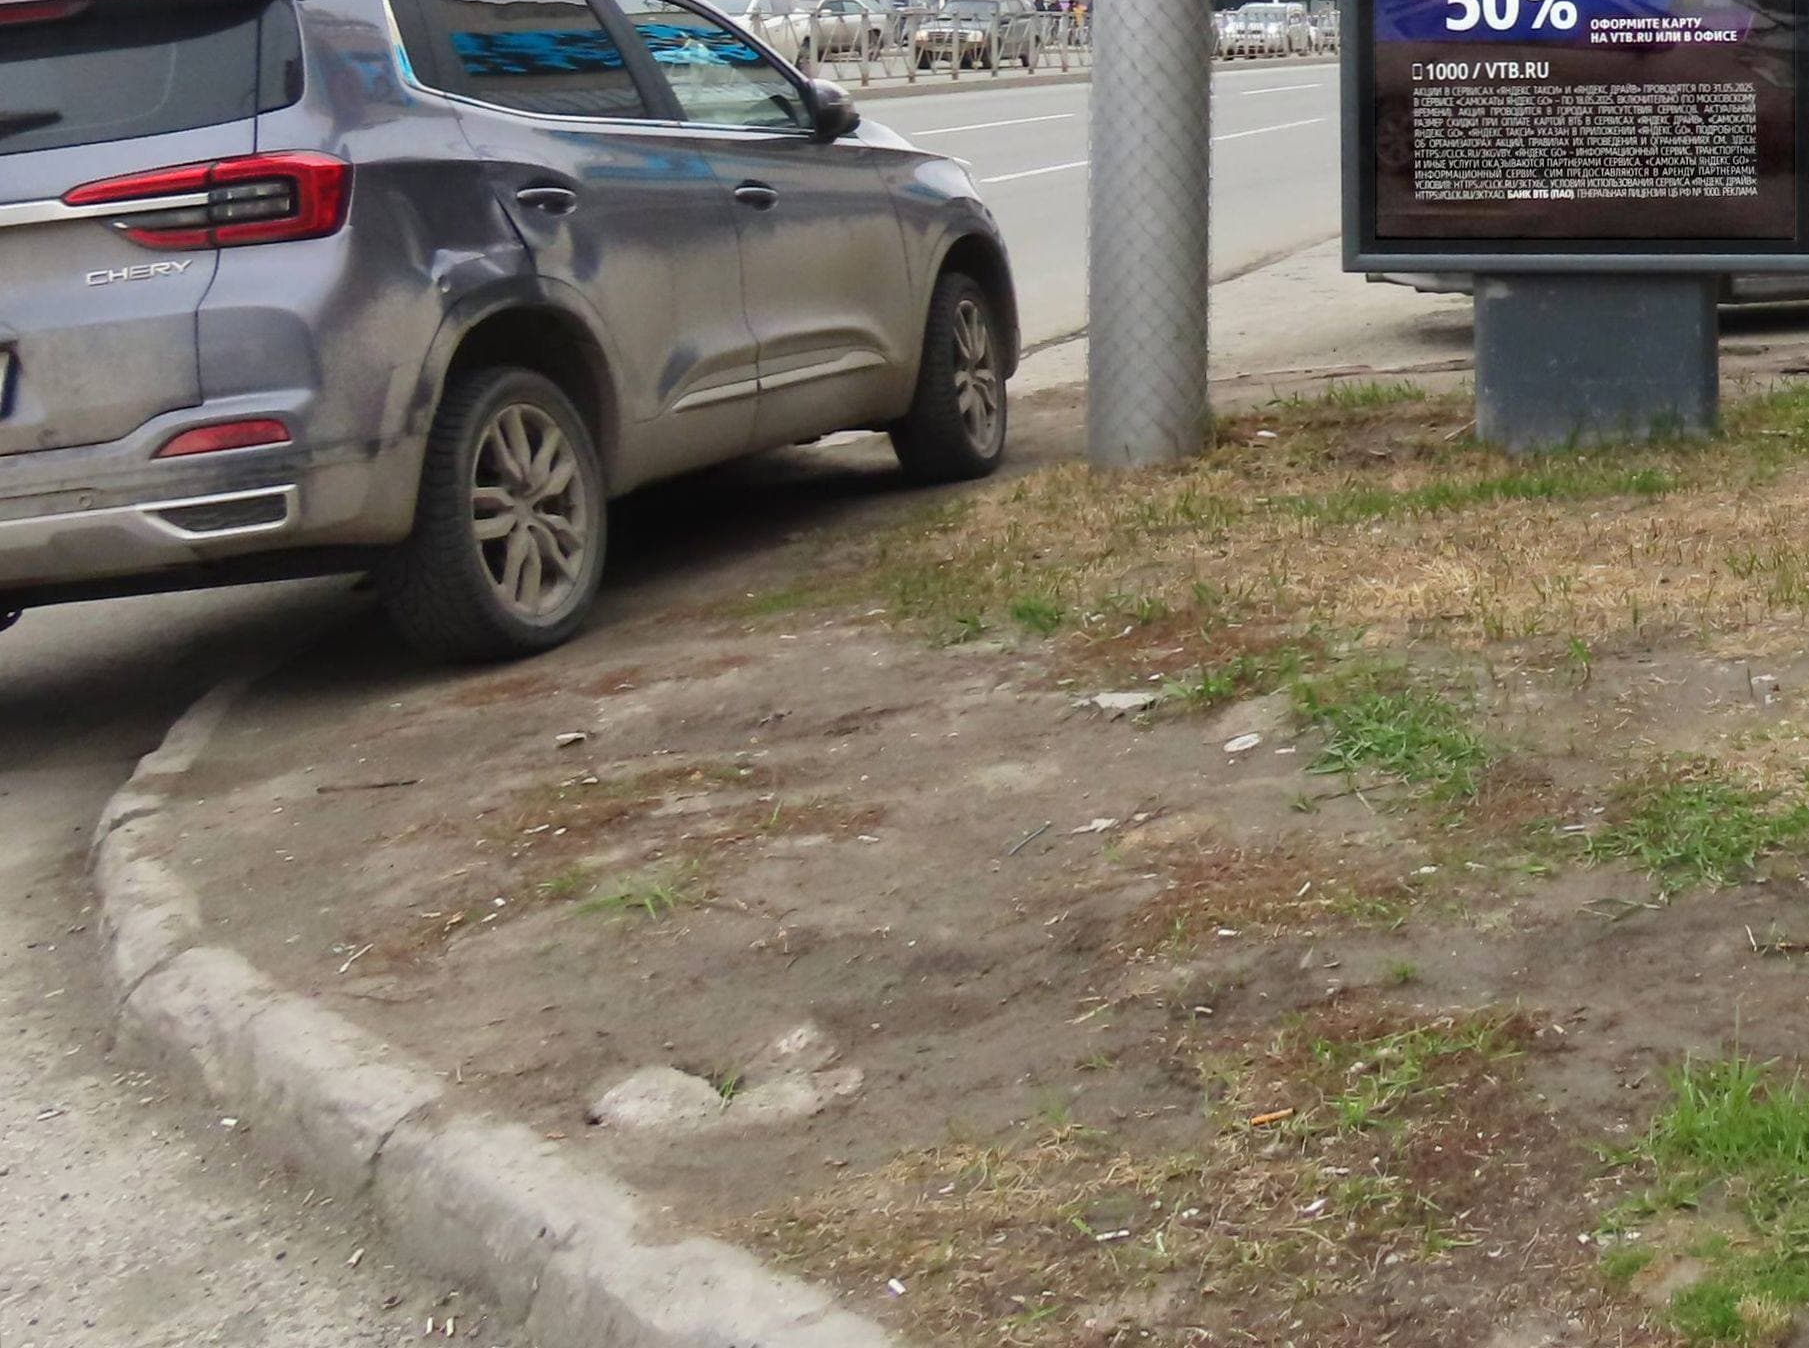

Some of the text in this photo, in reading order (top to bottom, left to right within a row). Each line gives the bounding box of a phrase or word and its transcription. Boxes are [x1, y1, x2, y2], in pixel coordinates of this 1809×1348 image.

[1590, 17, 1702, 30] ОФОРМИТЕ КАРТУ
[1590, 30, 1737, 43] НА VTB.RU ИЛИ В ОФИСЕ
[1425, 63, 1469, 81] 1000
[1485, 61, 1549, 80] VTB.RU
[1507, 189, 1532, 199] БАНК
[1532, 188, 1550, 198] ВТБ
[85, 259, 193, 287] CHERY
